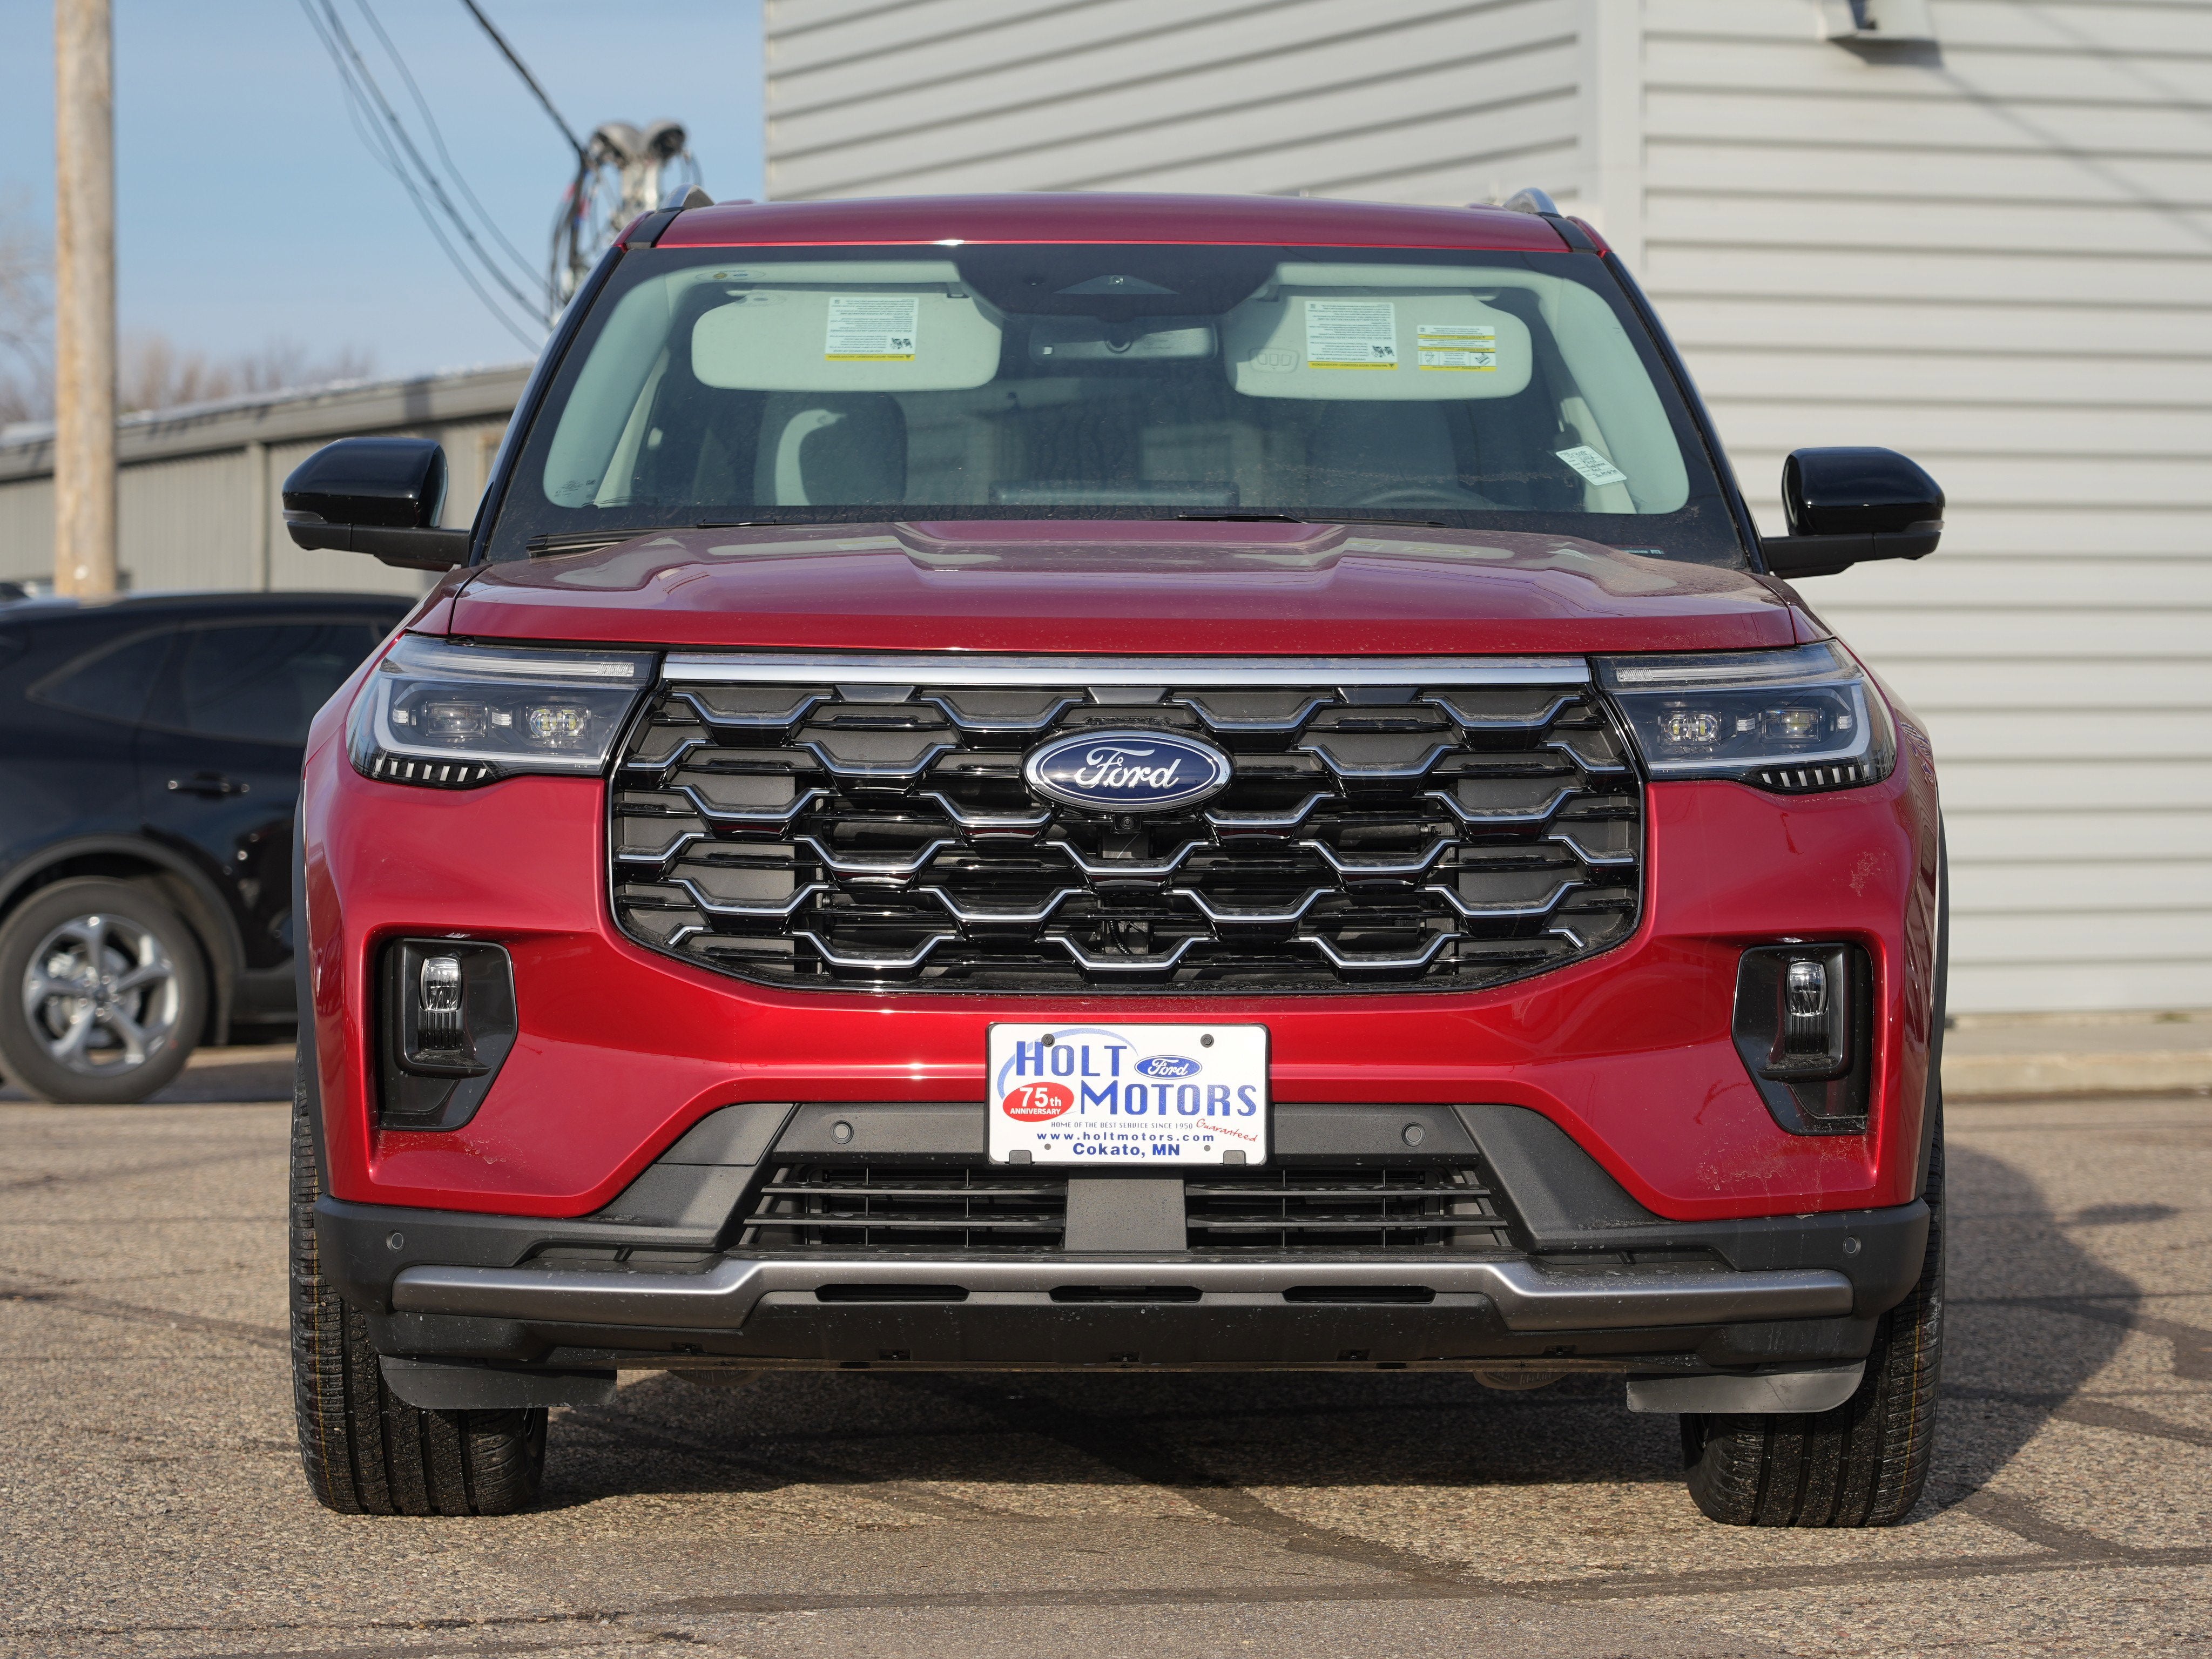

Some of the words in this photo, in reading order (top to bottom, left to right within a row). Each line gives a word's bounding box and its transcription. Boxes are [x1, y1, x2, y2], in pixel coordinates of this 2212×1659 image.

[1074, 747, 1182, 789] Ford
[1016, 1041, 1127, 1076] HOLT
[1148, 1058, 1190, 1076] Ford
[1020, 1087, 1062, 1107] 75th
[1081, 1080, 1257, 1116] MOTORS
[1036, 1131, 1214, 1142] www.holtmotors.com
[1196, 1118, 1258, 1142] Guaranteed
[1073, 1142, 1145, 1158] Cokato,
[1152, 1144, 1180, 1156] MN
